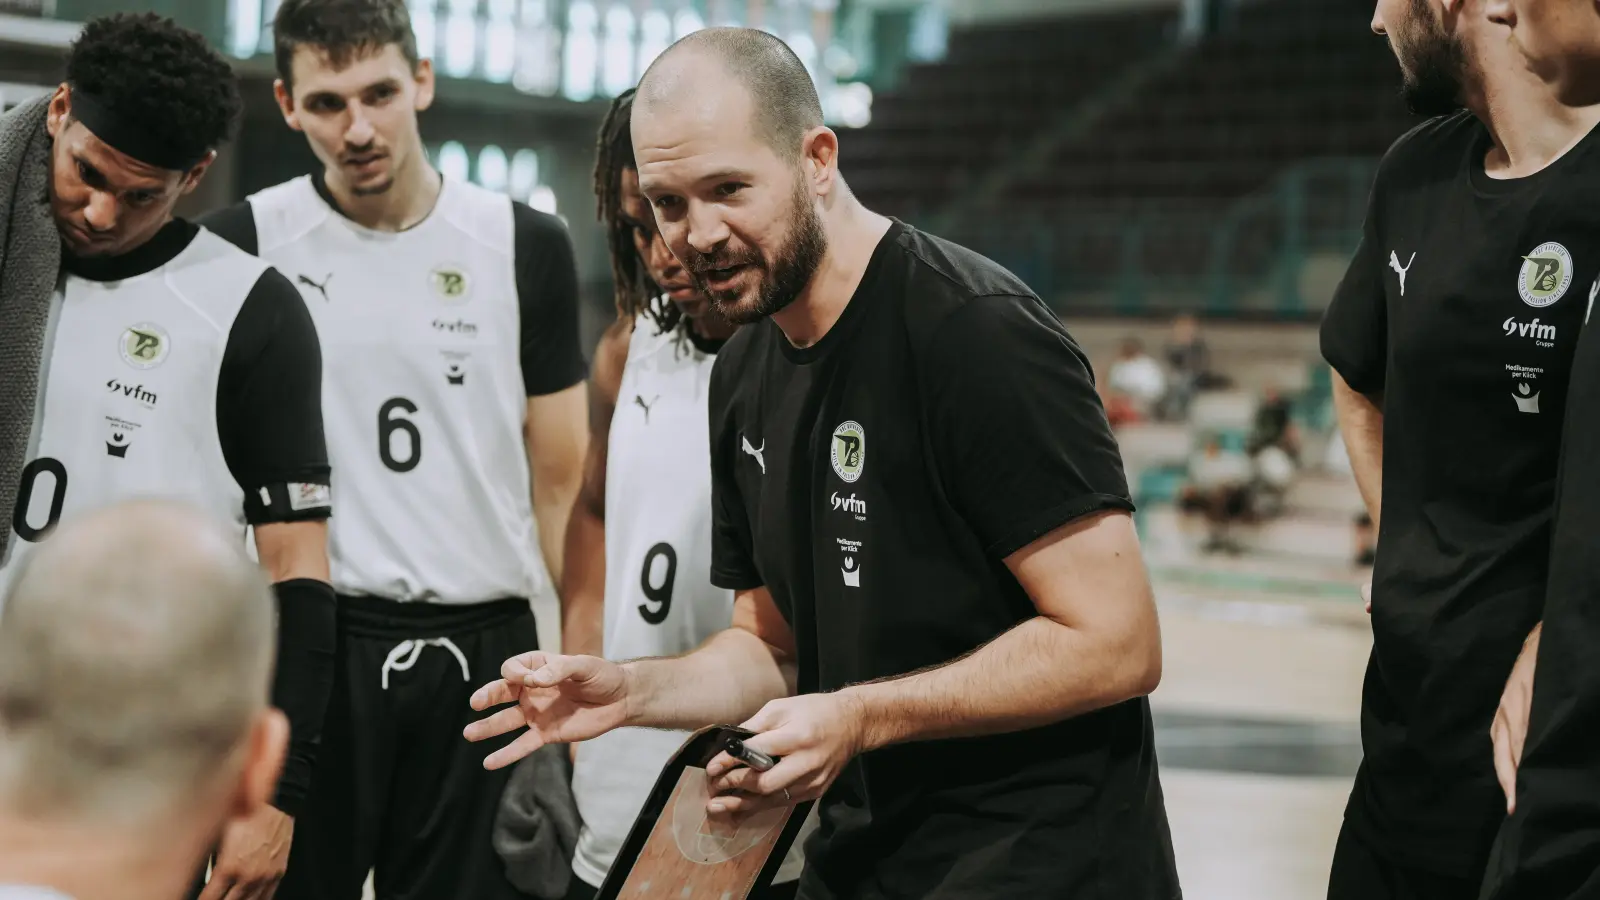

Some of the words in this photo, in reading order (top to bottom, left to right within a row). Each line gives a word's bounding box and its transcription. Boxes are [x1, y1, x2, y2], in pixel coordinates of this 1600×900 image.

[1519, 318, 1556, 340] vfm
[1535, 340, 1555, 348] Gruppe
[1505, 364, 1544, 373] Medikamente
[123, 384, 157, 404] vfm
[378, 397, 422, 473] 6
[841, 492, 866, 514] vfm
[637, 542, 677, 625] 9
